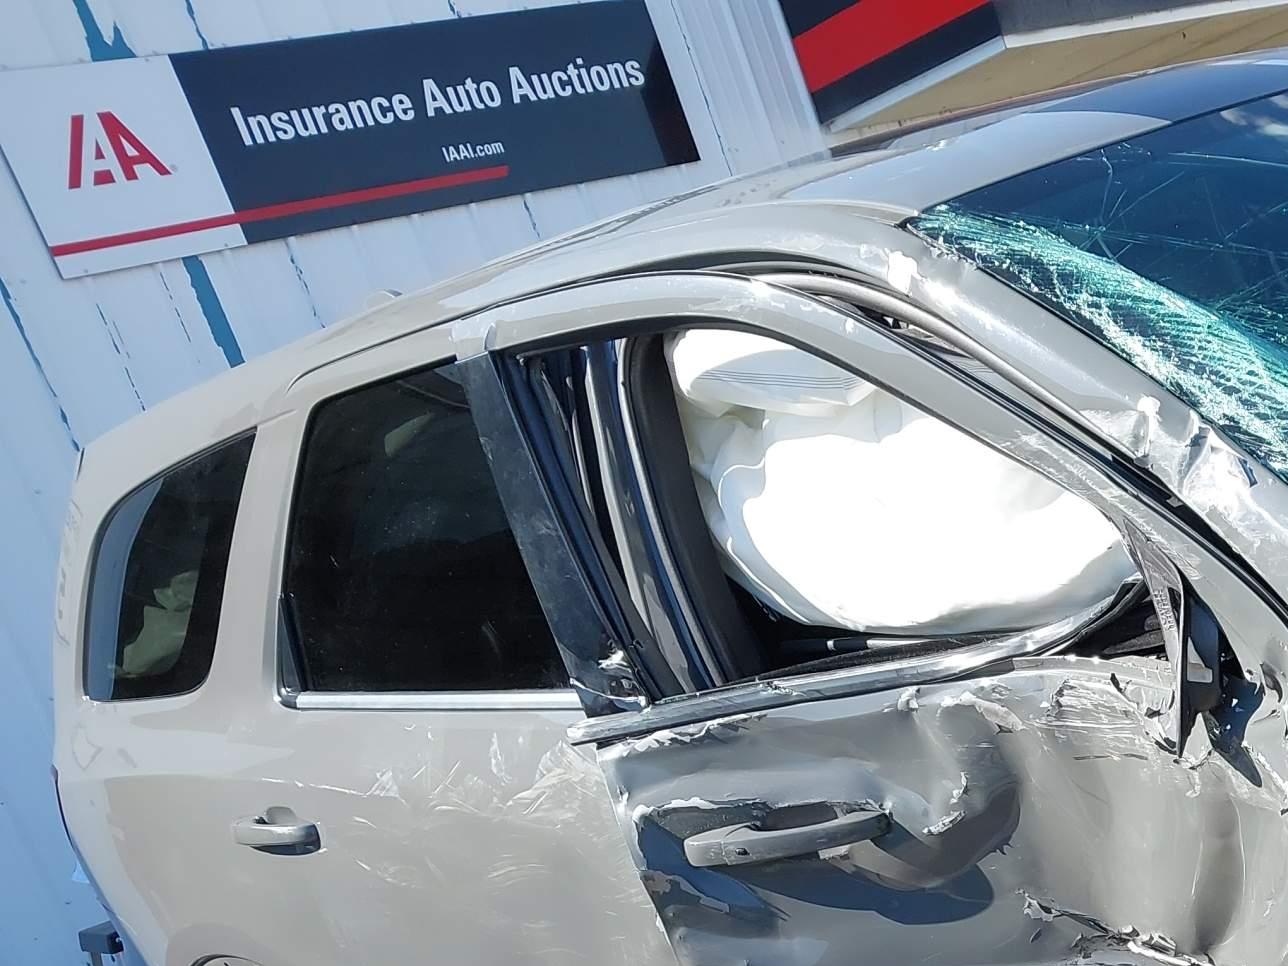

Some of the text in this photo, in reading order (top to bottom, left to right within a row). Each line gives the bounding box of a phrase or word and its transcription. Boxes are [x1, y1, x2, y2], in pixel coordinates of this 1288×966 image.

[231, 57, 645, 146] Insurance Auto Auctions
[67, 111, 173, 190] IAA
[442, 139, 506, 163] IAAI.com
